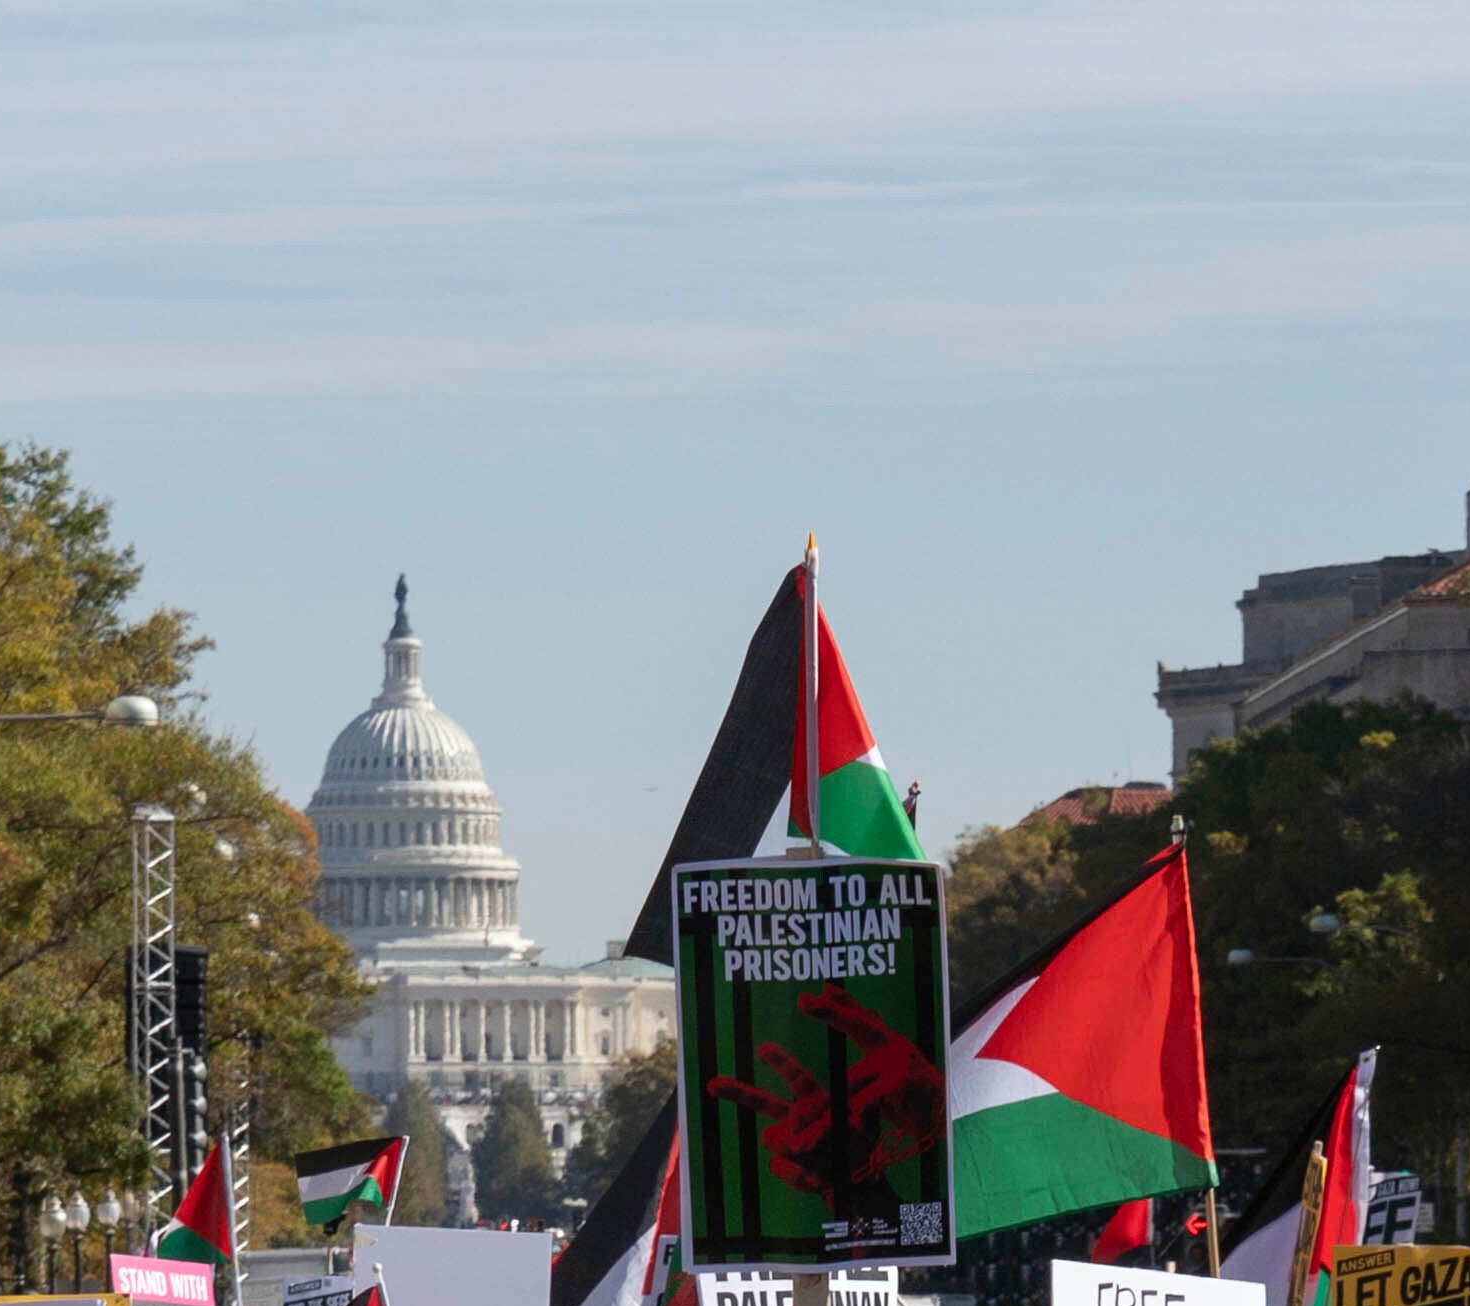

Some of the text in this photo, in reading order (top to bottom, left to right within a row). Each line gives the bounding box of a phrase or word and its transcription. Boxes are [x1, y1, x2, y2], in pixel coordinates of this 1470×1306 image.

[682, 874, 931, 914] FREEDOM TO ALL
[718, 908, 901, 946] PALESTINIAN
[725, 942, 896, 981] PRISONERS!
[1338, 1253, 1394, 1274] ANSWER
[119, 1267, 209, 1301] STAND WITH
